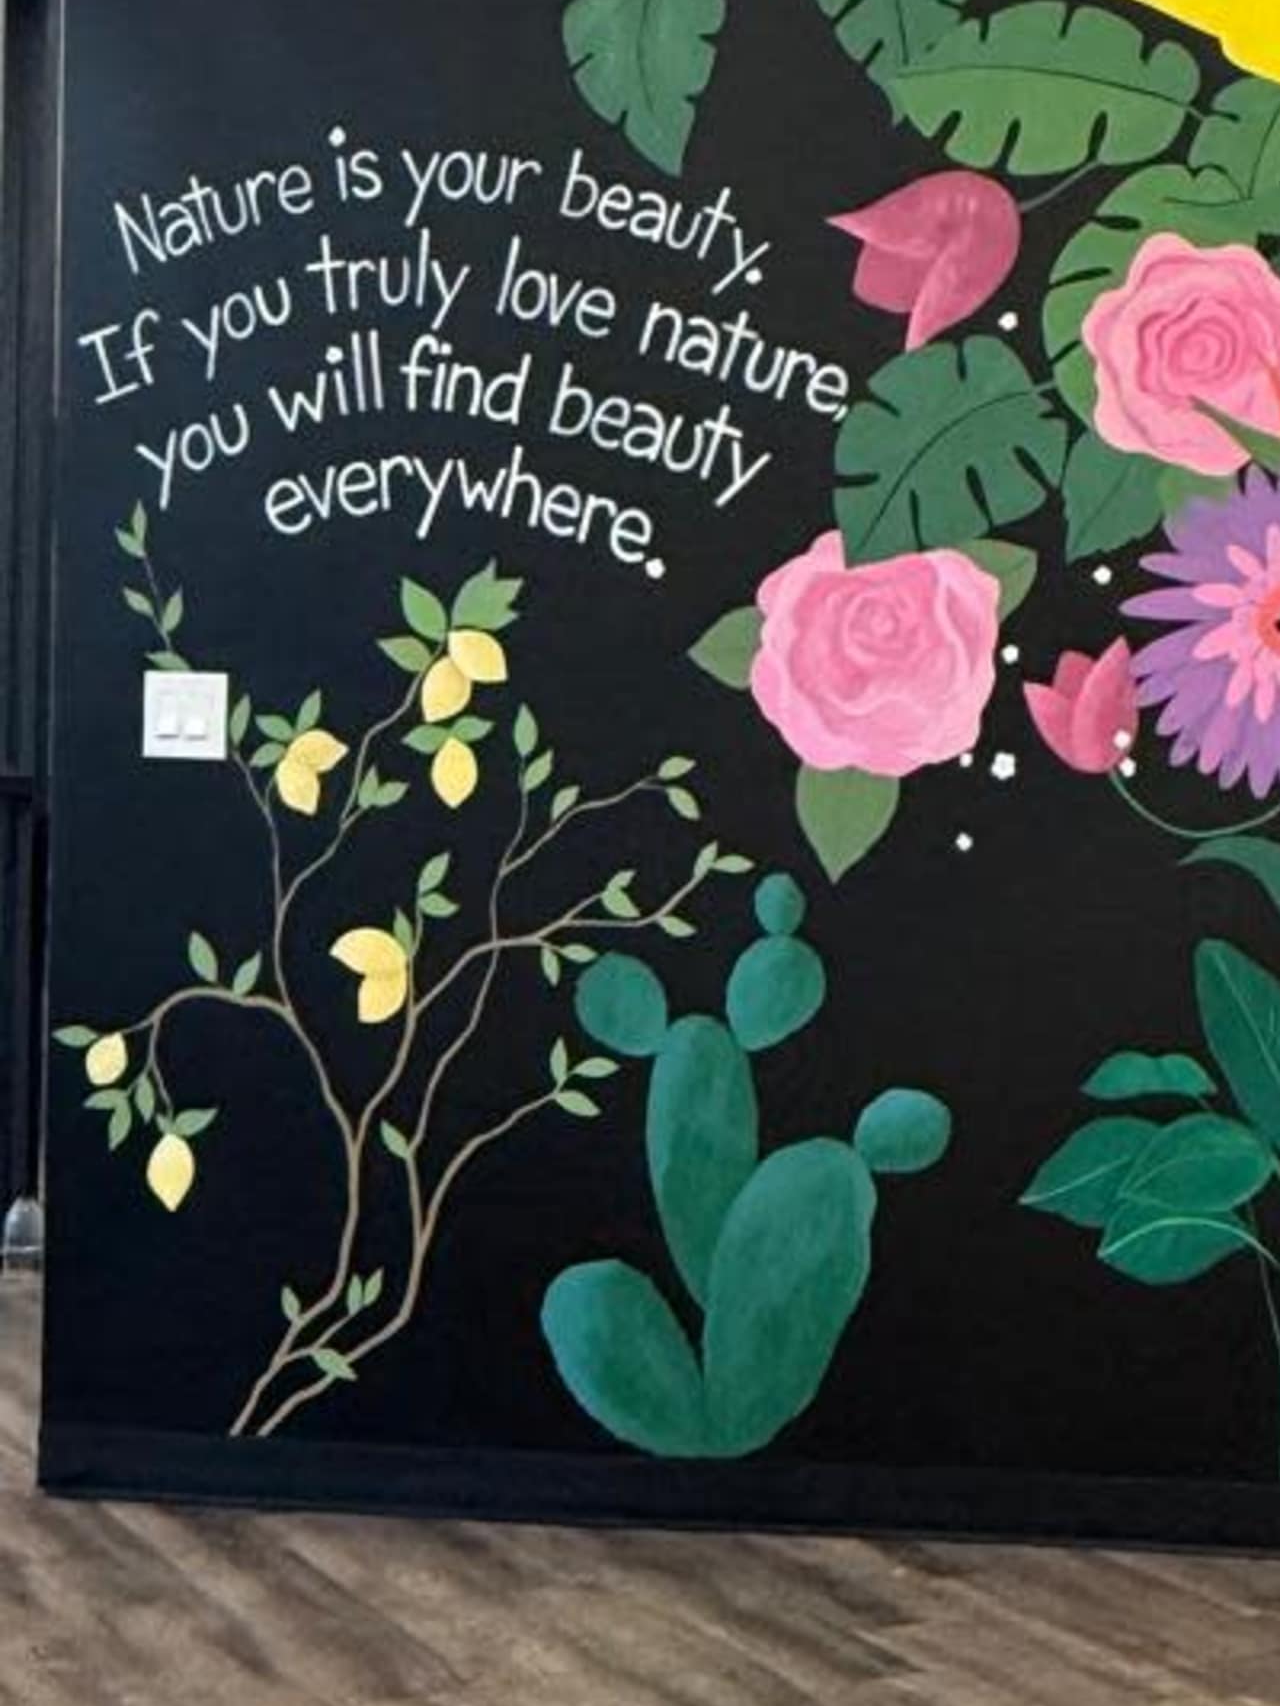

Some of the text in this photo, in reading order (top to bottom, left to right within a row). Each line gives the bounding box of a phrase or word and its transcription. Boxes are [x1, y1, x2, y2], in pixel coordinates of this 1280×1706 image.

[114, 126, 771, 295] Nature is your beauty.
[78, 228, 855, 423] If you truly love nature,
[136, 329, 772, 509] you will find beauty
[264, 445, 668, 580] everywhere.
